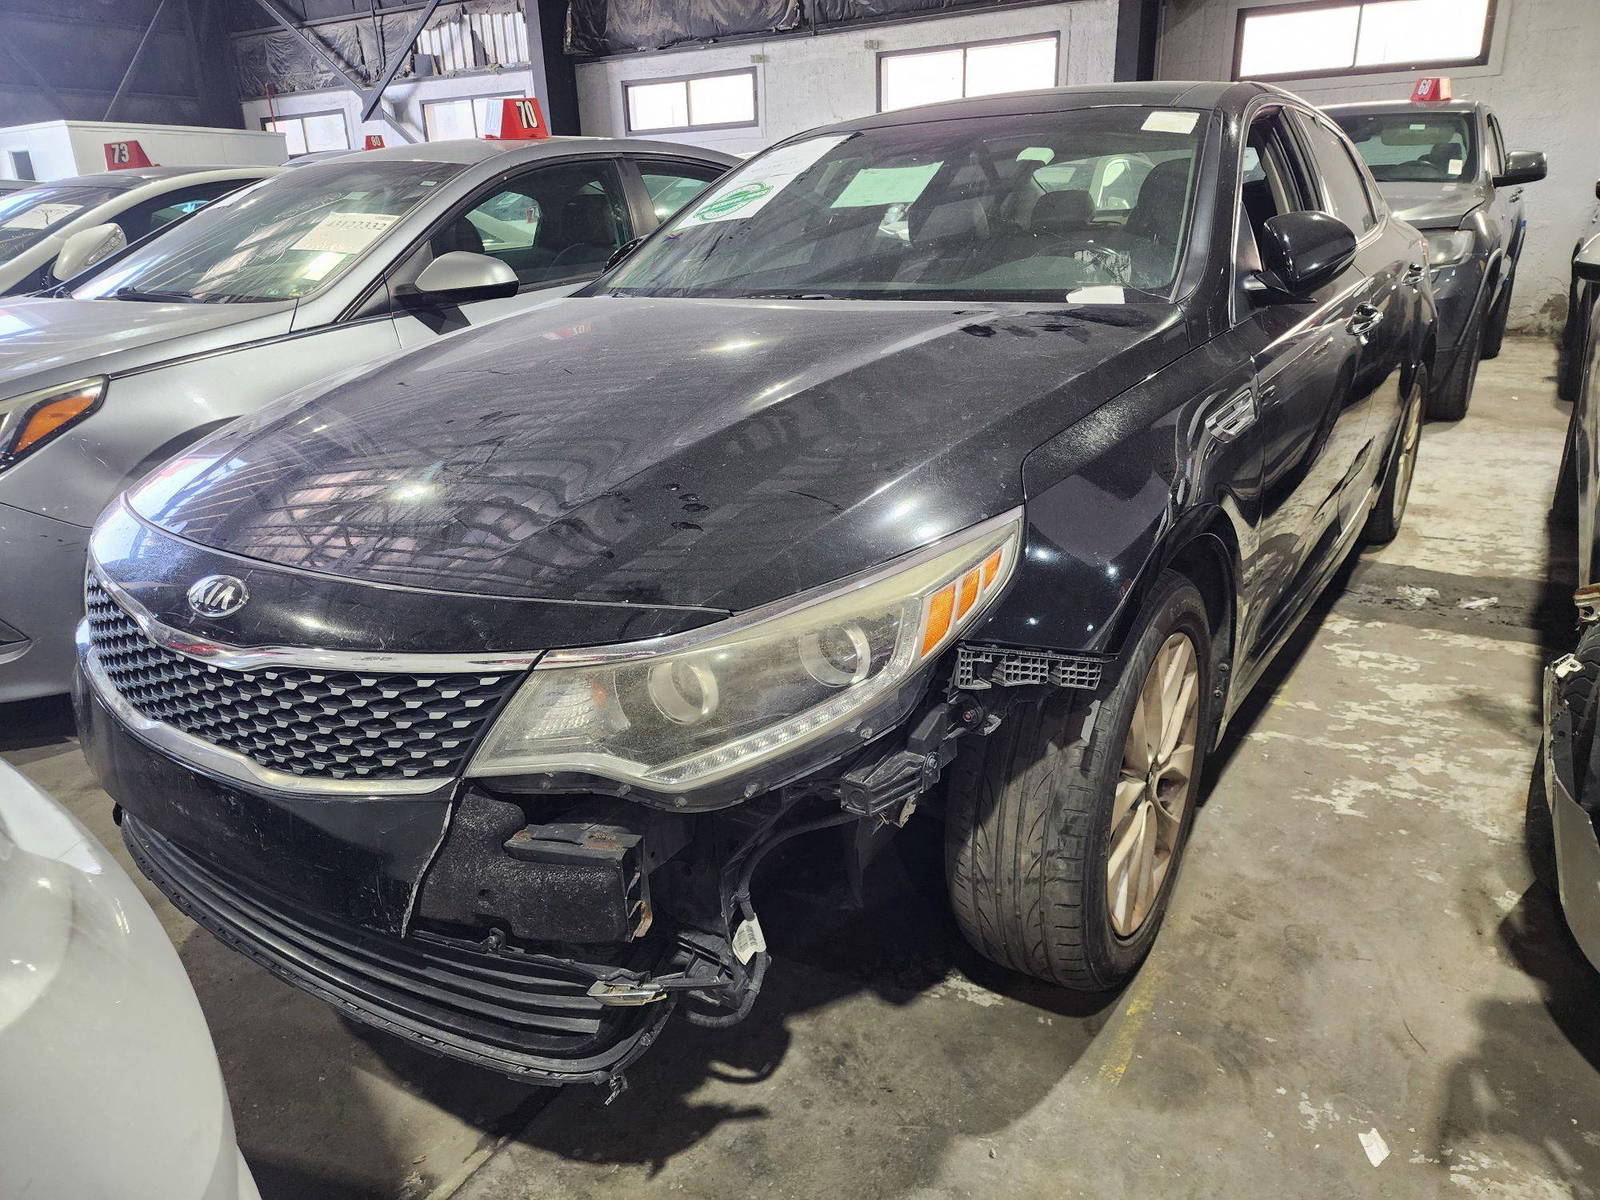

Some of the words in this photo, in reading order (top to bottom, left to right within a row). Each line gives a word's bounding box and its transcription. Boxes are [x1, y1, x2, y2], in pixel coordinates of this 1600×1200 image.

[515, 101, 538, 128] 70
[111, 143, 129, 164] 73
[190, 580, 236, 610] KIA
